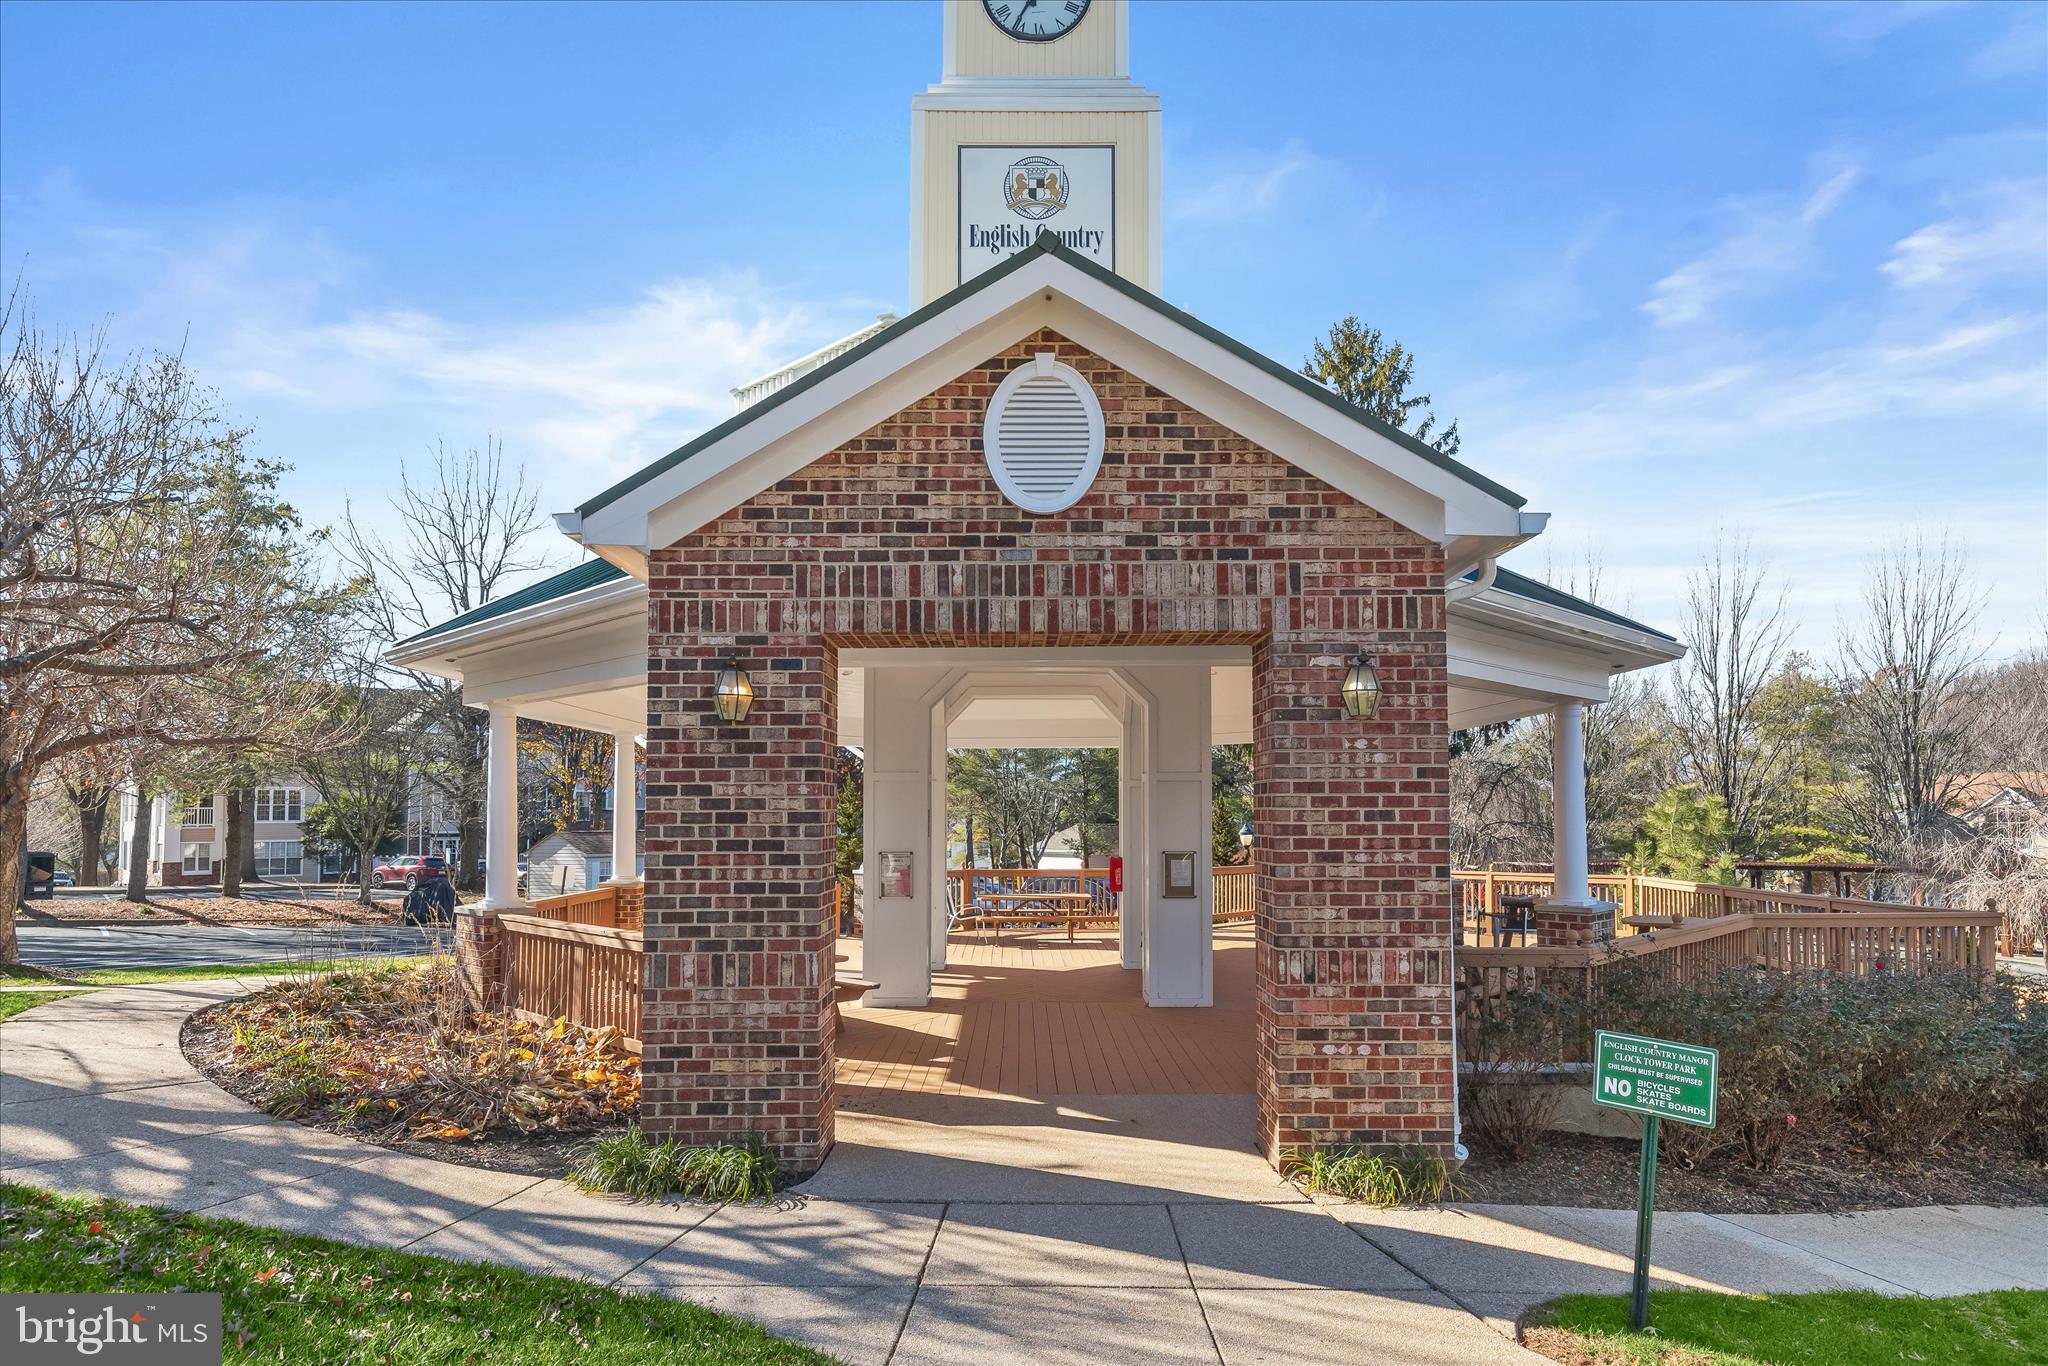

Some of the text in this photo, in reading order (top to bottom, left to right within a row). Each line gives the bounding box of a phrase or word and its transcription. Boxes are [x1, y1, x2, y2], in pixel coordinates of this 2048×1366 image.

[969, 223, 1104, 254] English Cuntry
[1604, 1041, 1709, 1066] ENGLISH COUNTRY MANOR
[1614, 1053, 1697, 1075] CLOCK TOWER PARK
[1608, 1063, 1637, 1074] CHILDREN
[1638, 1068, 1655, 1077] MUST
[1665, 1073, 1703, 1086] SUPERVISED
[1604, 1077, 1632, 1097] NO
[1636, 1088, 1672, 1101] SKATES
[1637, 1080, 1681, 1095] BICYCLES
[1636, 1096, 1706, 1116] SKATE BOARDS
